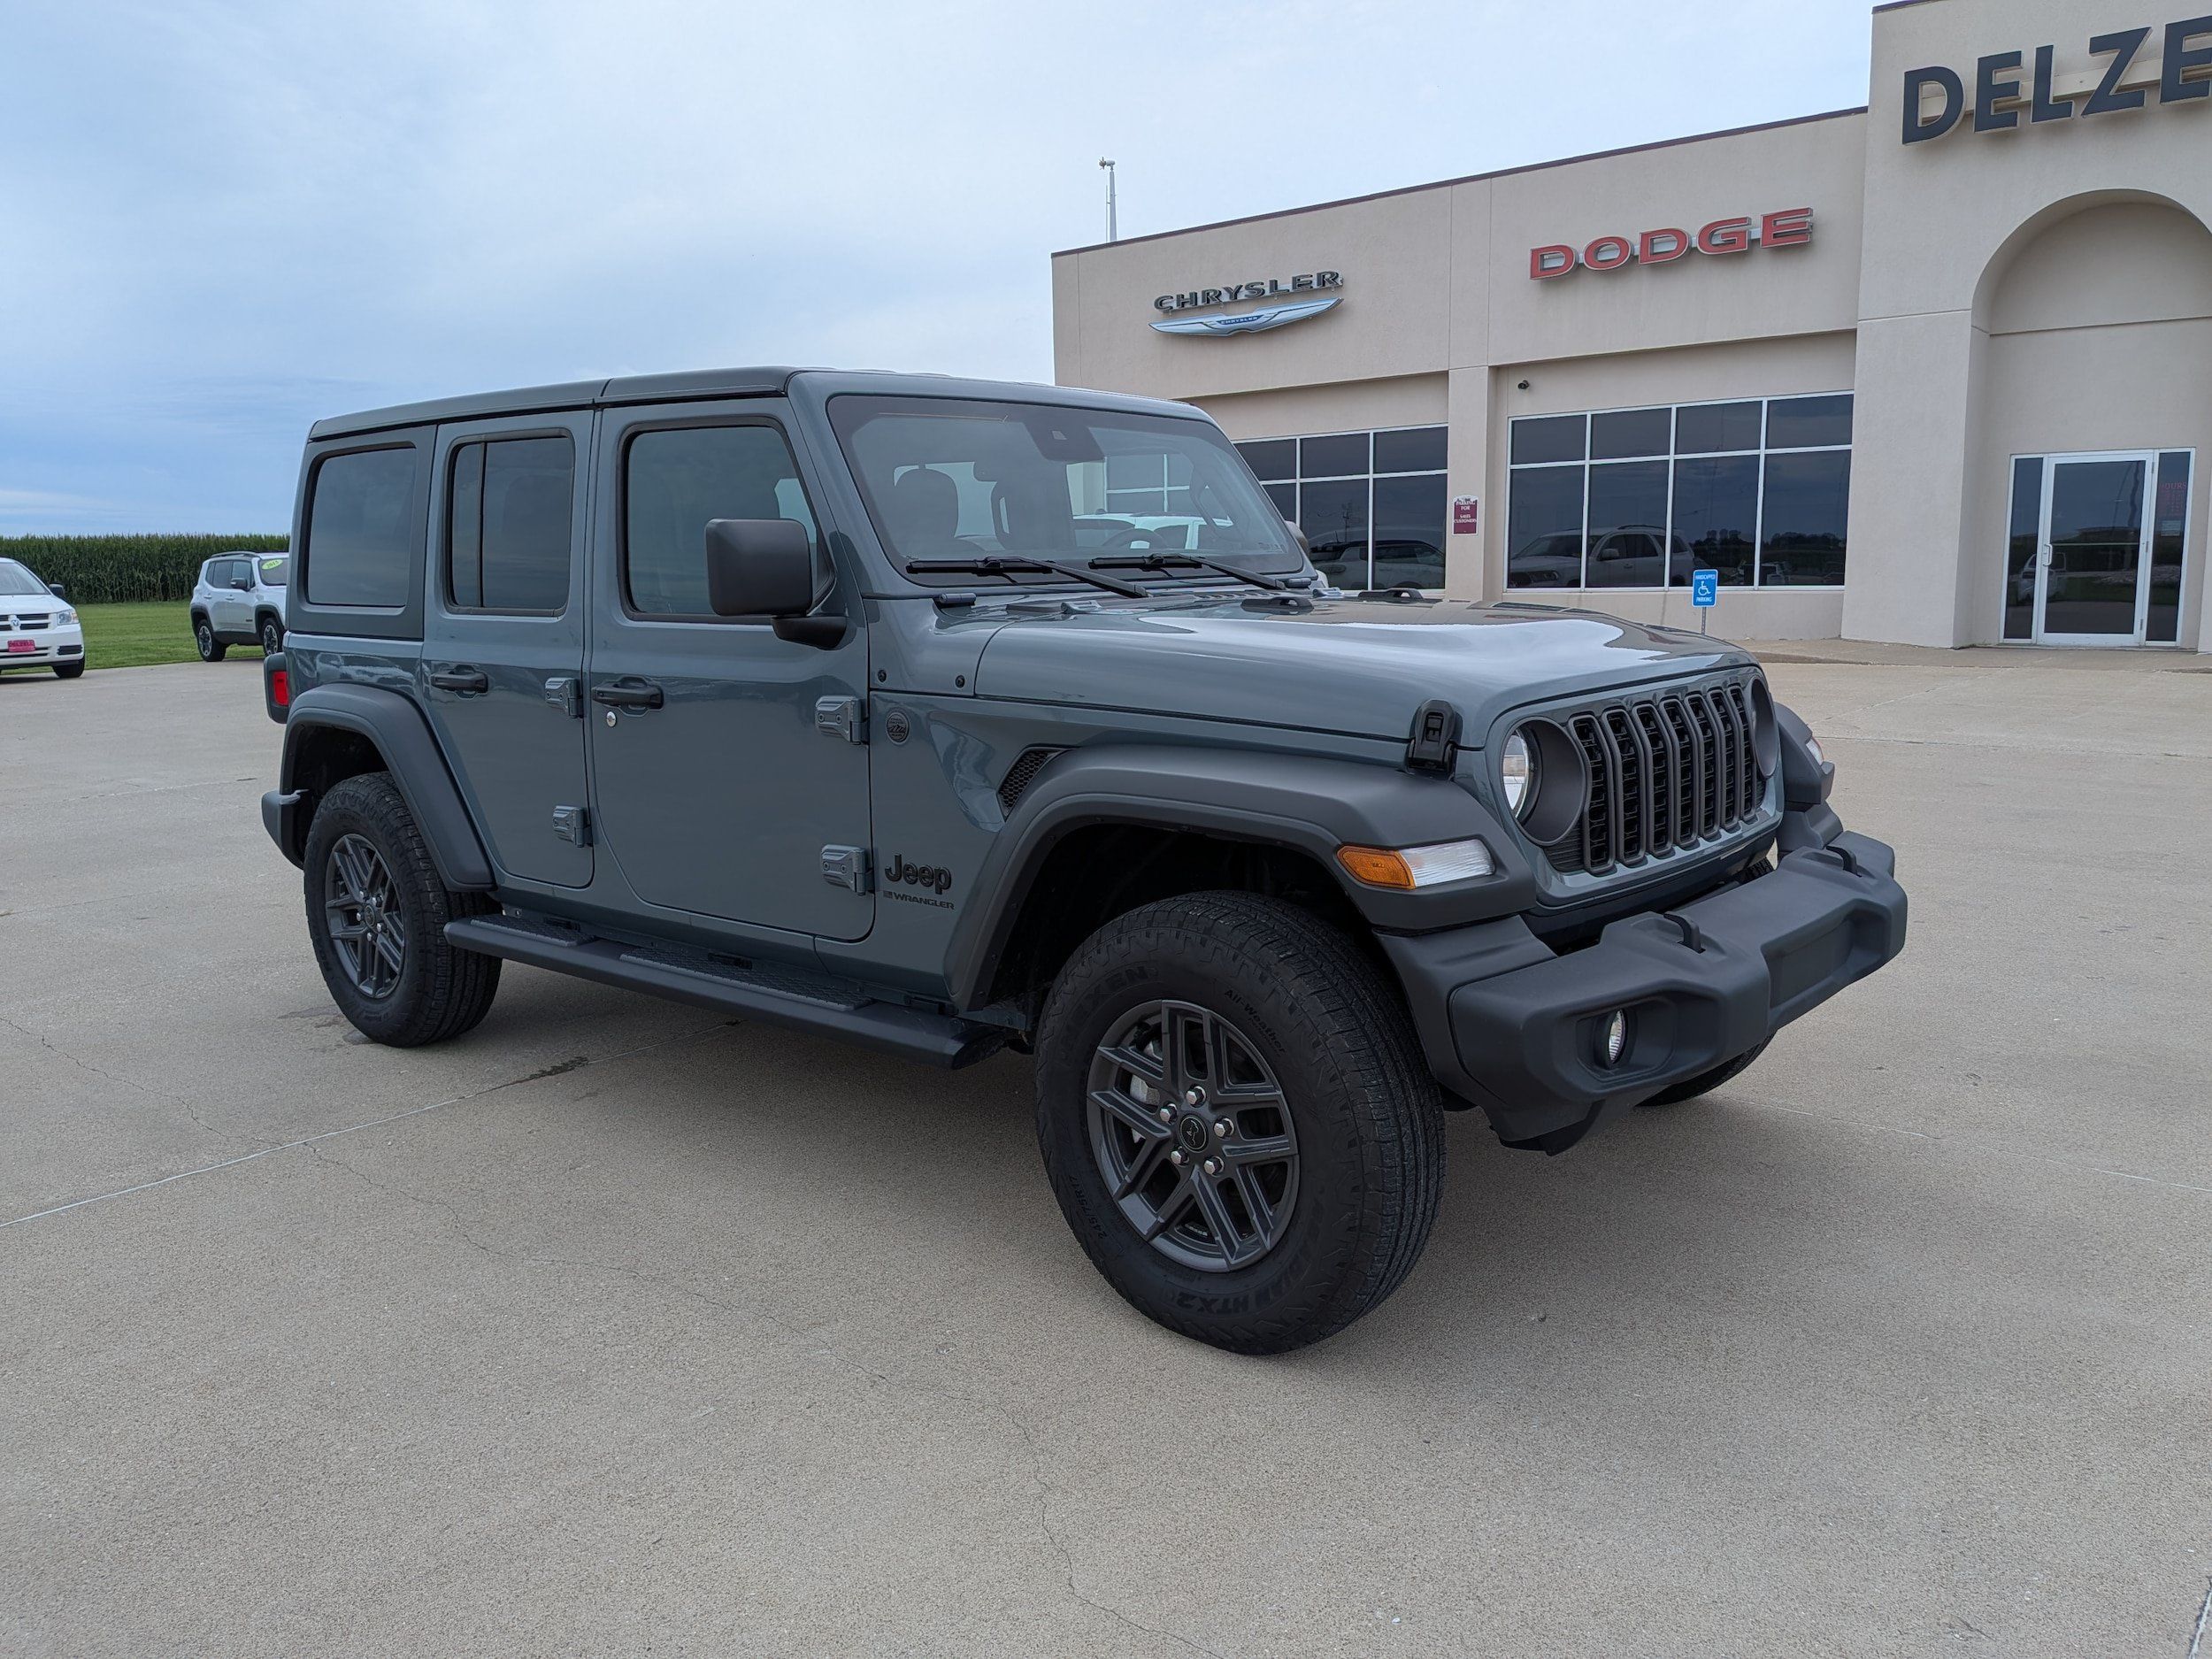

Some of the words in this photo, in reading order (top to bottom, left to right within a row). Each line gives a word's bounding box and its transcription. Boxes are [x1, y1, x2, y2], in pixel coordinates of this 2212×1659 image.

[1901, 15, 2212, 146] DELZE
[1529, 206, 1815, 281] DODGE
[1153, 270, 1343, 312] CHRYSLER
[884, 853, 952, 895] Jeep
[892, 891, 956, 910] WRANGLER
[1176, 1290, 1250, 1315] HTX2
